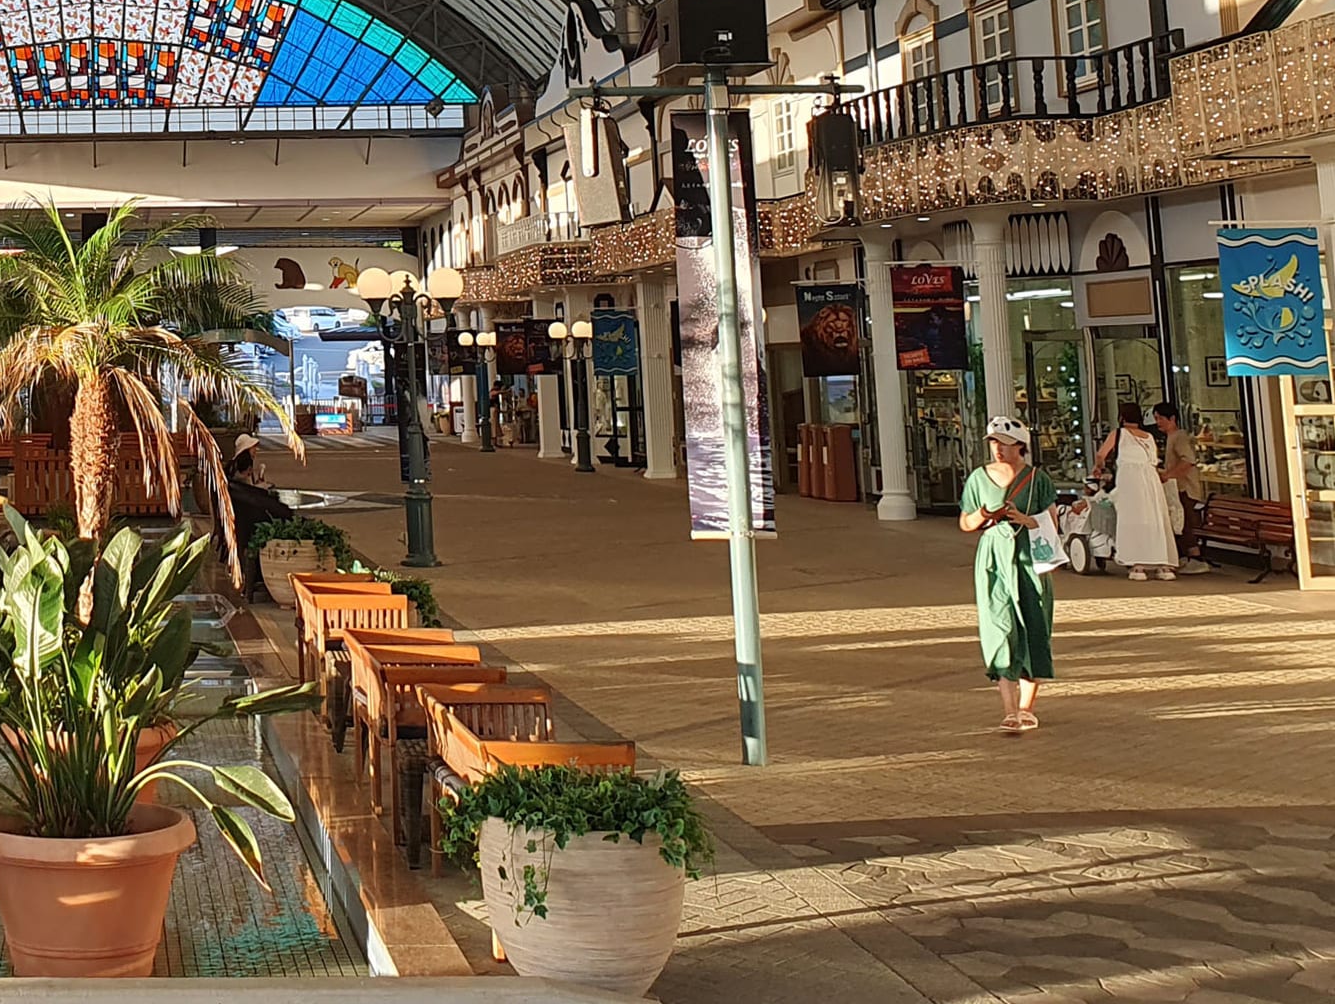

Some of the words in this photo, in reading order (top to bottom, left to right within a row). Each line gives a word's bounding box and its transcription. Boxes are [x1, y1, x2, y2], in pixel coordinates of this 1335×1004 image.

[684, 136, 739, 153] LOS
[910, 273, 945, 285] LOVES
[1239, 274, 1314, 303] SPLASH!
